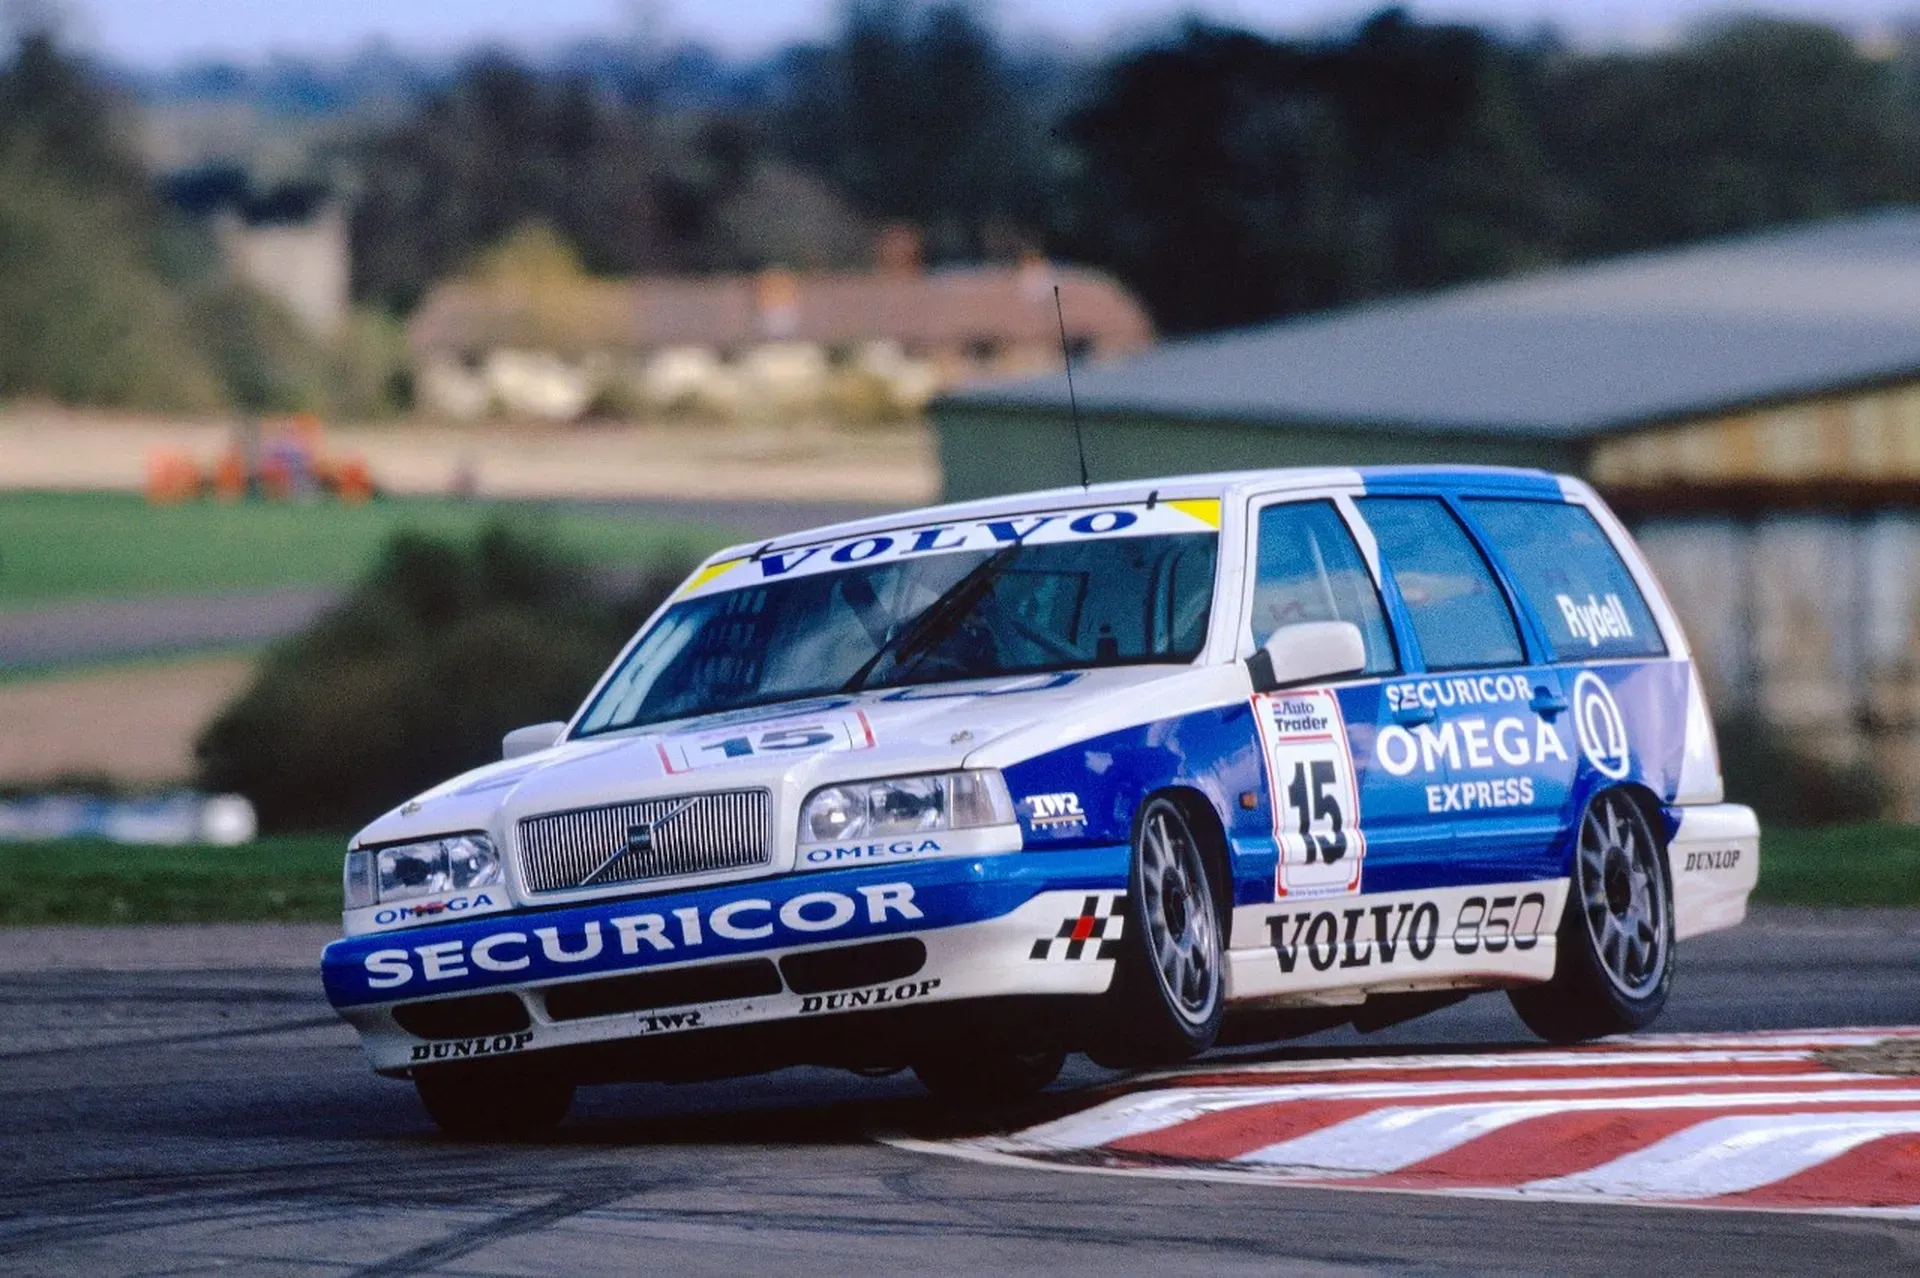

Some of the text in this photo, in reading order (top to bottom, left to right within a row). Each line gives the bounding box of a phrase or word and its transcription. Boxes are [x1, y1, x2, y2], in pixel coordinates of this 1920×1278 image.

[758, 510, 1138, 577] VOLVO
[1555, 593, 1633, 647] Rydell
[1281, 701, 1315, 716] Auto
[1386, 674, 1534, 712] SECURICOR
[701, 725, 834, 758] 15
[1274, 717, 1328, 732] Trader
[1376, 716, 1568, 776] OMEGA
[1025, 792, 1085, 818] TWR
[1426, 776, 1535, 813] EXPRESS
[1288, 761, 1347, 865] 15
[807, 840, 941, 862] OMEGA
[1685, 850, 1741, 871] DUNLOP
[364, 882, 924, 989] SECURICOR
[1266, 892, 1545, 973] VOLVO 850
[800, 979, 941, 1013] DUNLOP
[411, 1032, 533, 1061] DUNLOP
